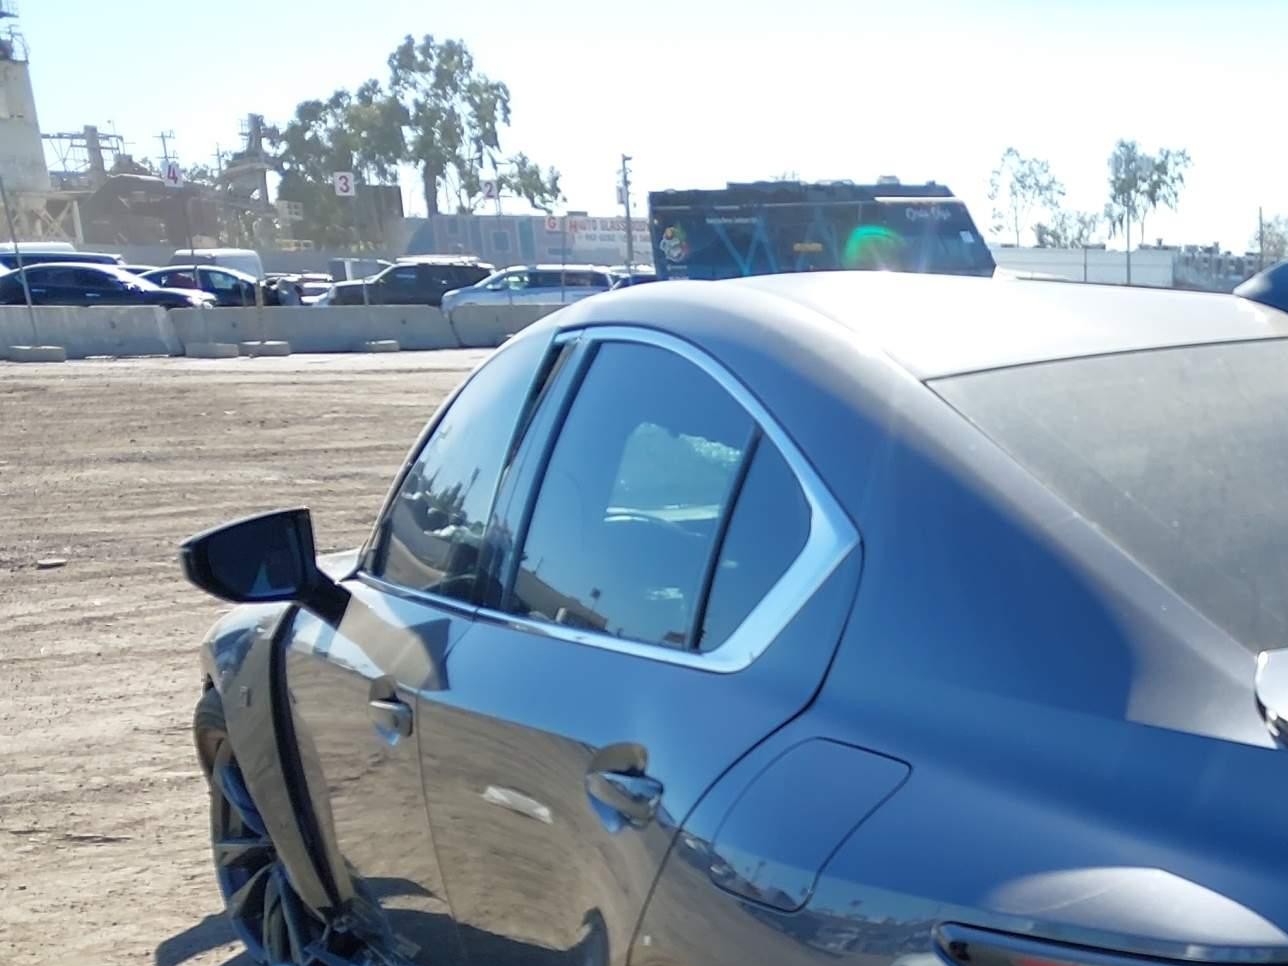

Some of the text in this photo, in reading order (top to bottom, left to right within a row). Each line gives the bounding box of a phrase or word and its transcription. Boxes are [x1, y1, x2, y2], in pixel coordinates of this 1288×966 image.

[167, 165, 178, 184] 4
[339, 175, 350, 193] 3
[484, 182, 495, 198] 2
[547, 216, 557, 230] G
[568, 220, 577, 233] H
